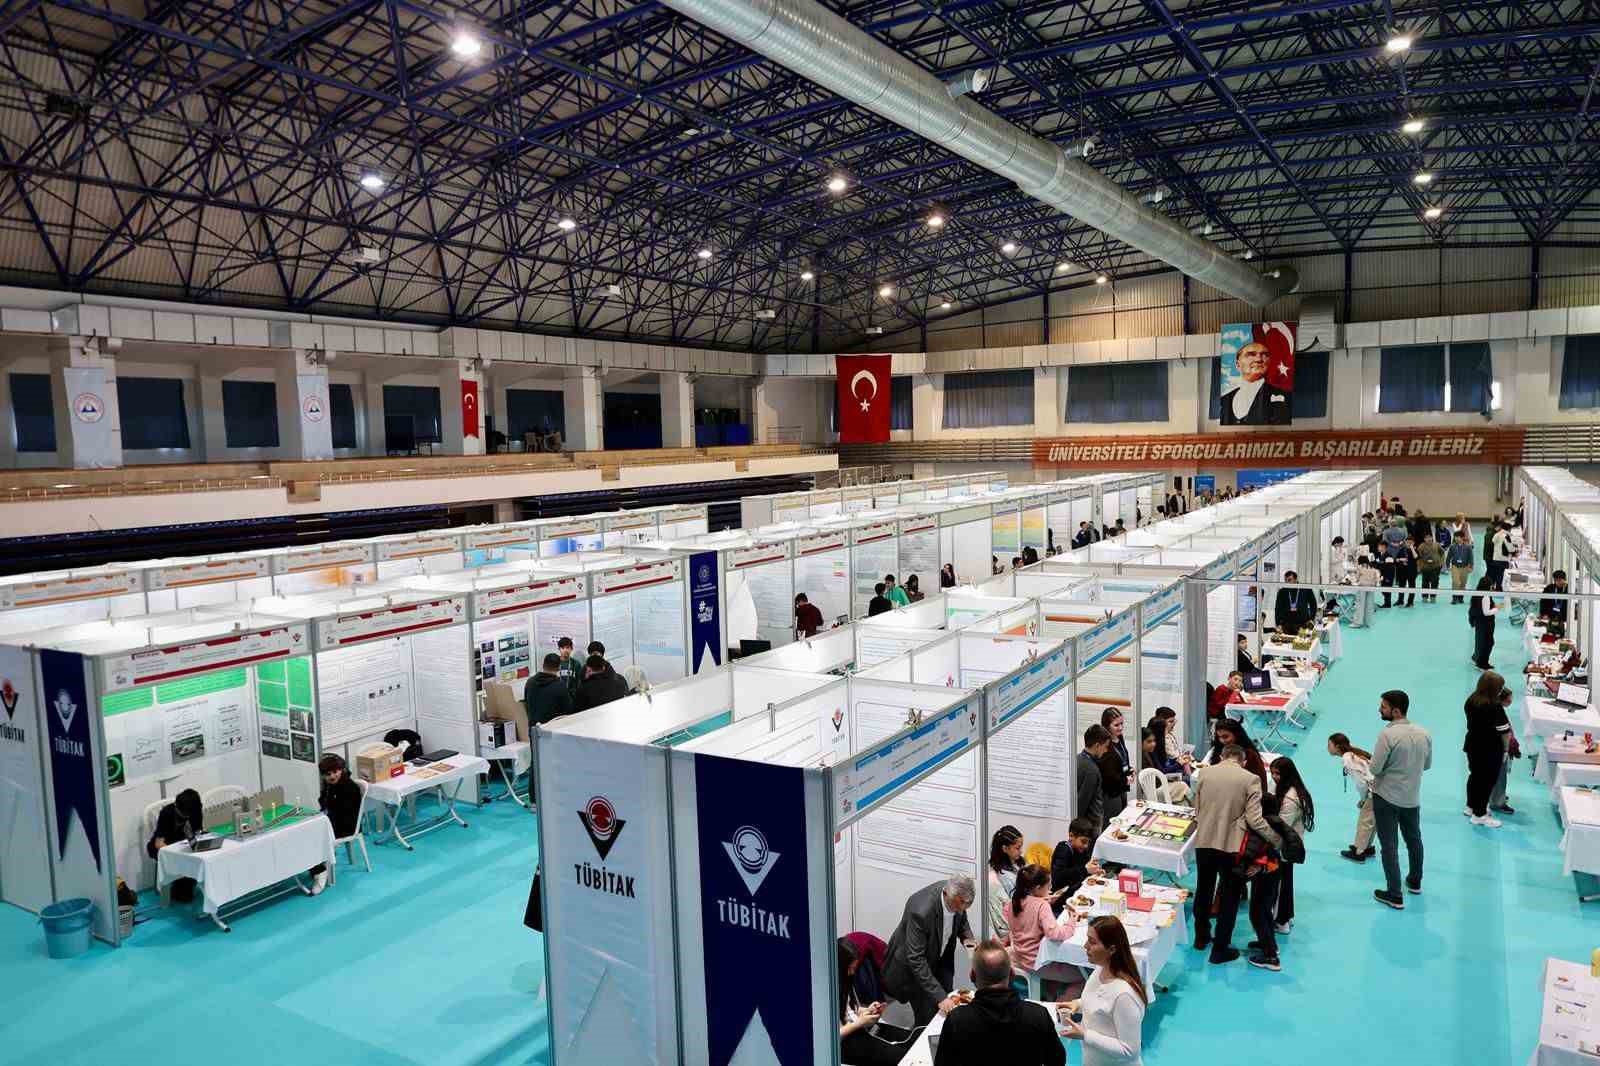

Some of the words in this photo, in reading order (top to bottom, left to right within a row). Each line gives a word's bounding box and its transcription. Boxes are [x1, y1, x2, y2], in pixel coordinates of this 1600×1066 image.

[1049, 441, 1149, 461] ÜNİVERSİTELİ
[1150, 441, 1295, 461] SPORCULARIMIZA
[1300, 438, 1405, 460] BAŞARILAR
[1407, 433, 1486, 456] DİLERİZ
[574, 862, 636, 898] TÜBİTAK
[717, 897, 791, 939] TÜBİTAK
